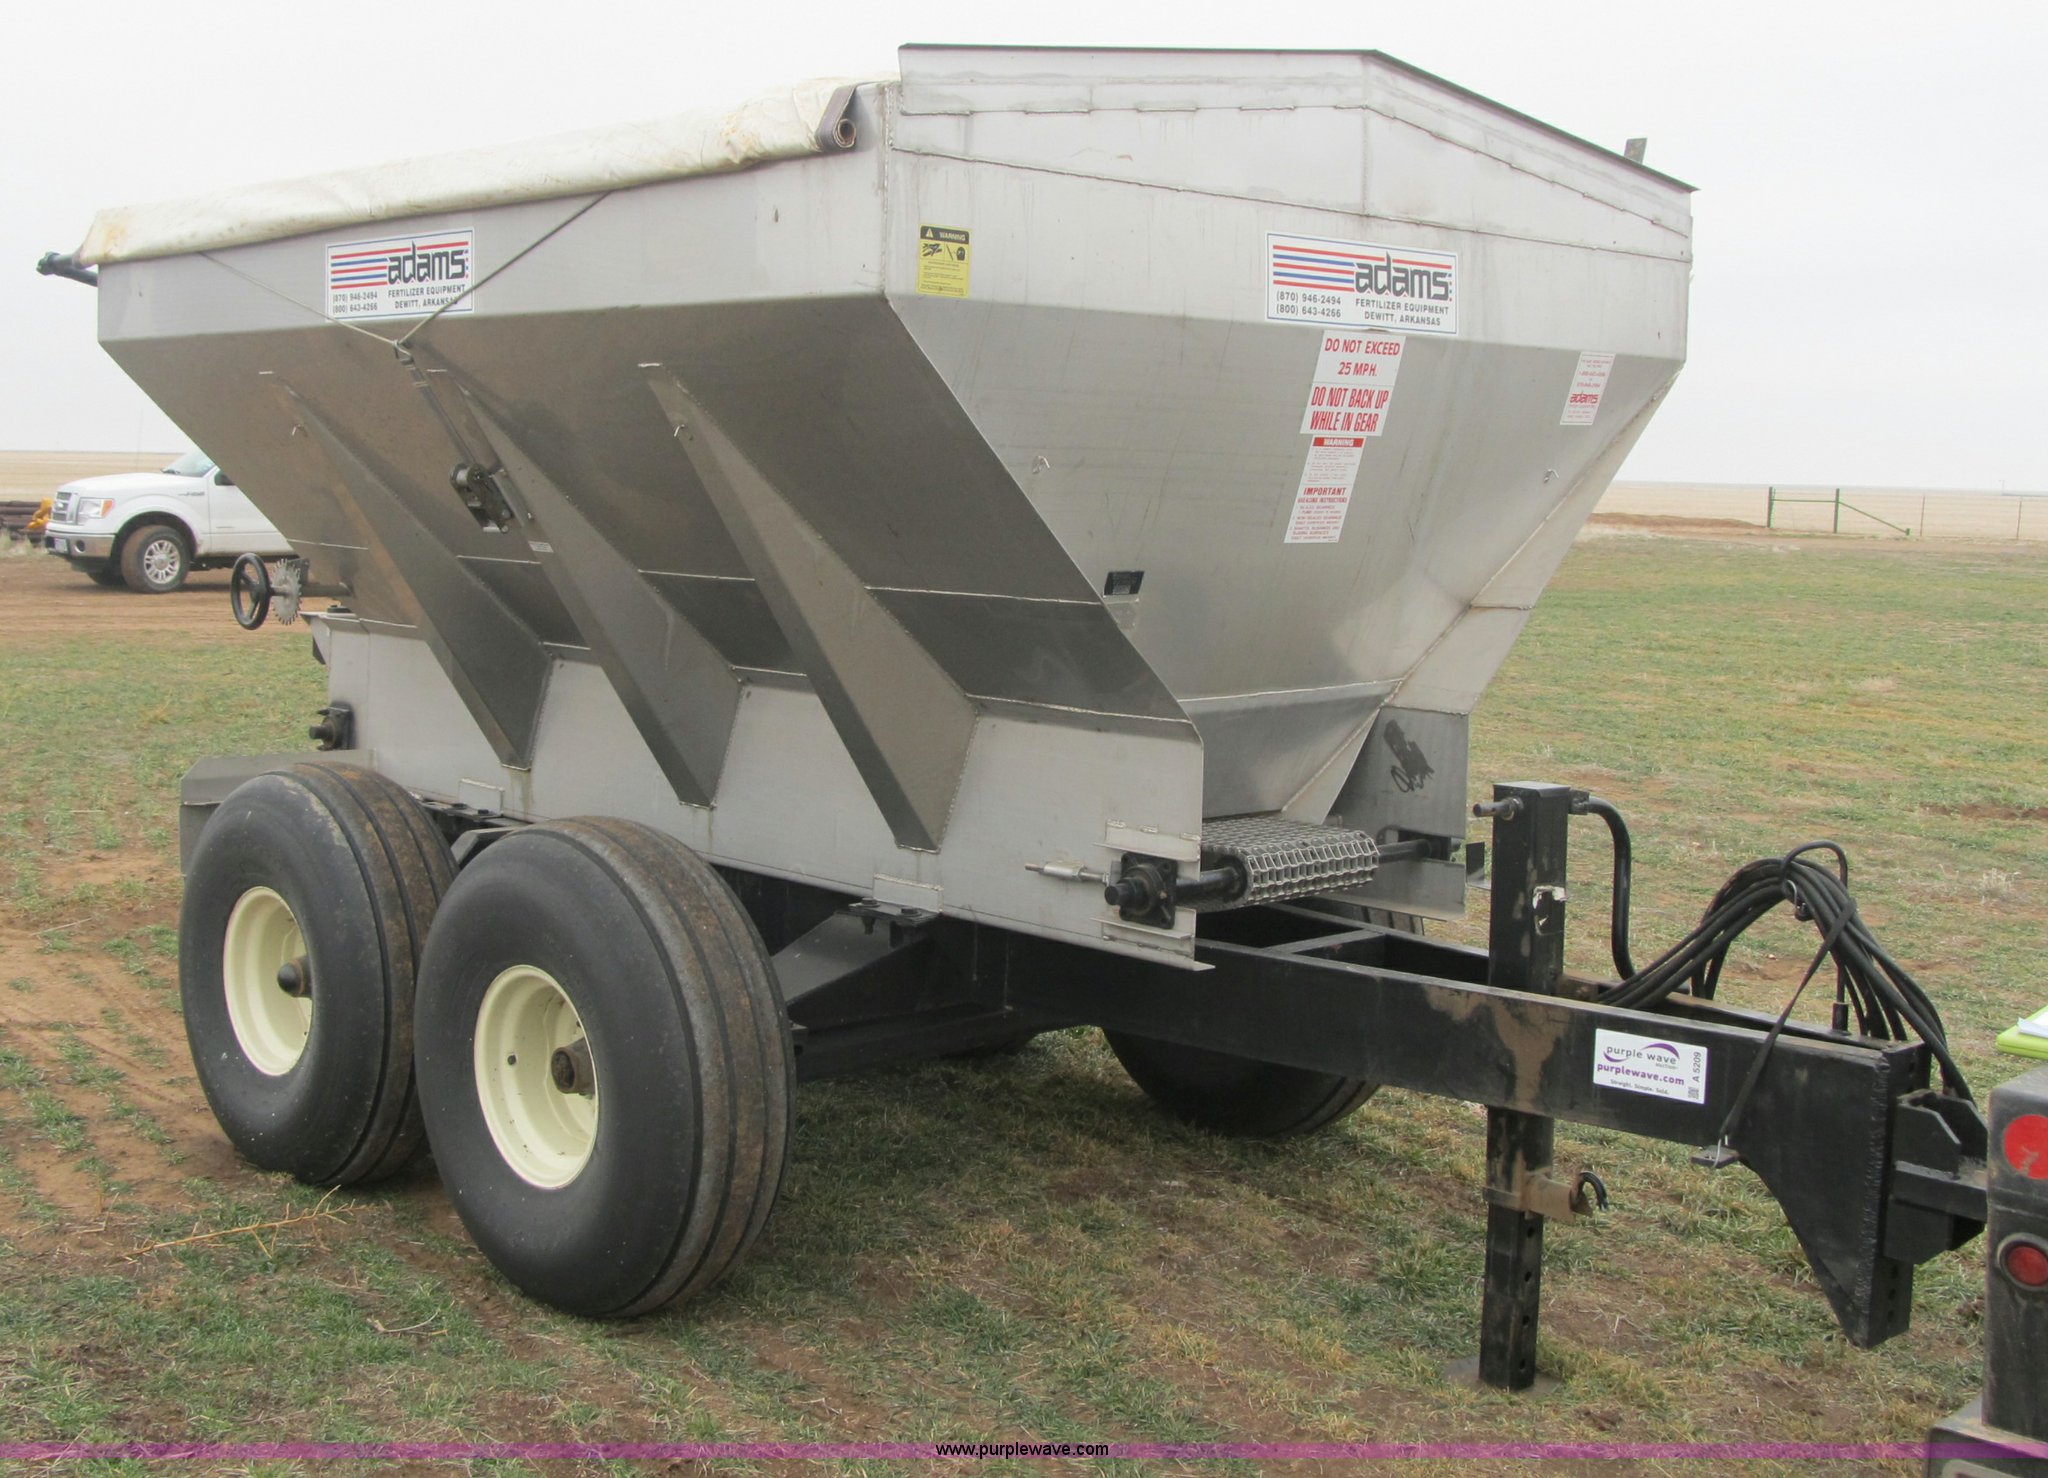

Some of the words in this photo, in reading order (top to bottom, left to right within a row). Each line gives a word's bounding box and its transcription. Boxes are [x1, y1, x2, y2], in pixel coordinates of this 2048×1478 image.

[939, 231, 966, 241] WARNING
[388, 240, 466, 285] adams
[1355, 251, 1450, 300] adams
[332, 295, 349, 303] (870)
[388, 288, 425, 299] FERTILIZER
[426, 284, 466, 295] EQUIPMENT
[1276, 291, 1299, 302] (870)
[1301, 293, 1341, 305] 946-2494
[332, 306, 349, 314] (800)
[1276, 304, 1299, 316] (800)
[1301, 305, 1341, 318] 643-4266
[1355, 298, 1401, 310] FERTILIZER
[1404, 303, 1450, 315] EQUIPMENT
[1364, 311, 1397, 323] DEWITT,
[1399, 315, 1441, 326] ARKANSAS
[1325, 338, 1340, 352] DO
[1342, 339, 1362, 353] NOT
[1365, 341, 1401, 356] EXCEED
[1338, 361, 1352, 375] 25
[1311, 386, 1326, 406] DO
[1326, 387, 1348, 407] NOT
[1348, 388, 1375, 408] BACK
[1374, 390, 1389, 409] UP
[1310, 411, 1341, 431] WHILE
[1341, 412, 1354, 431] IN
[1353, 412, 1379, 432] GEAR
[1303, 487, 1346, 496] IMPORTANT
[1607, 1046, 1643, 1060] purple
[1646, 1052, 1677, 1065] wave
[1693, 1051, 1702, 1074] 5209
[1597, 1063, 1685, 1085] purplewave.com
